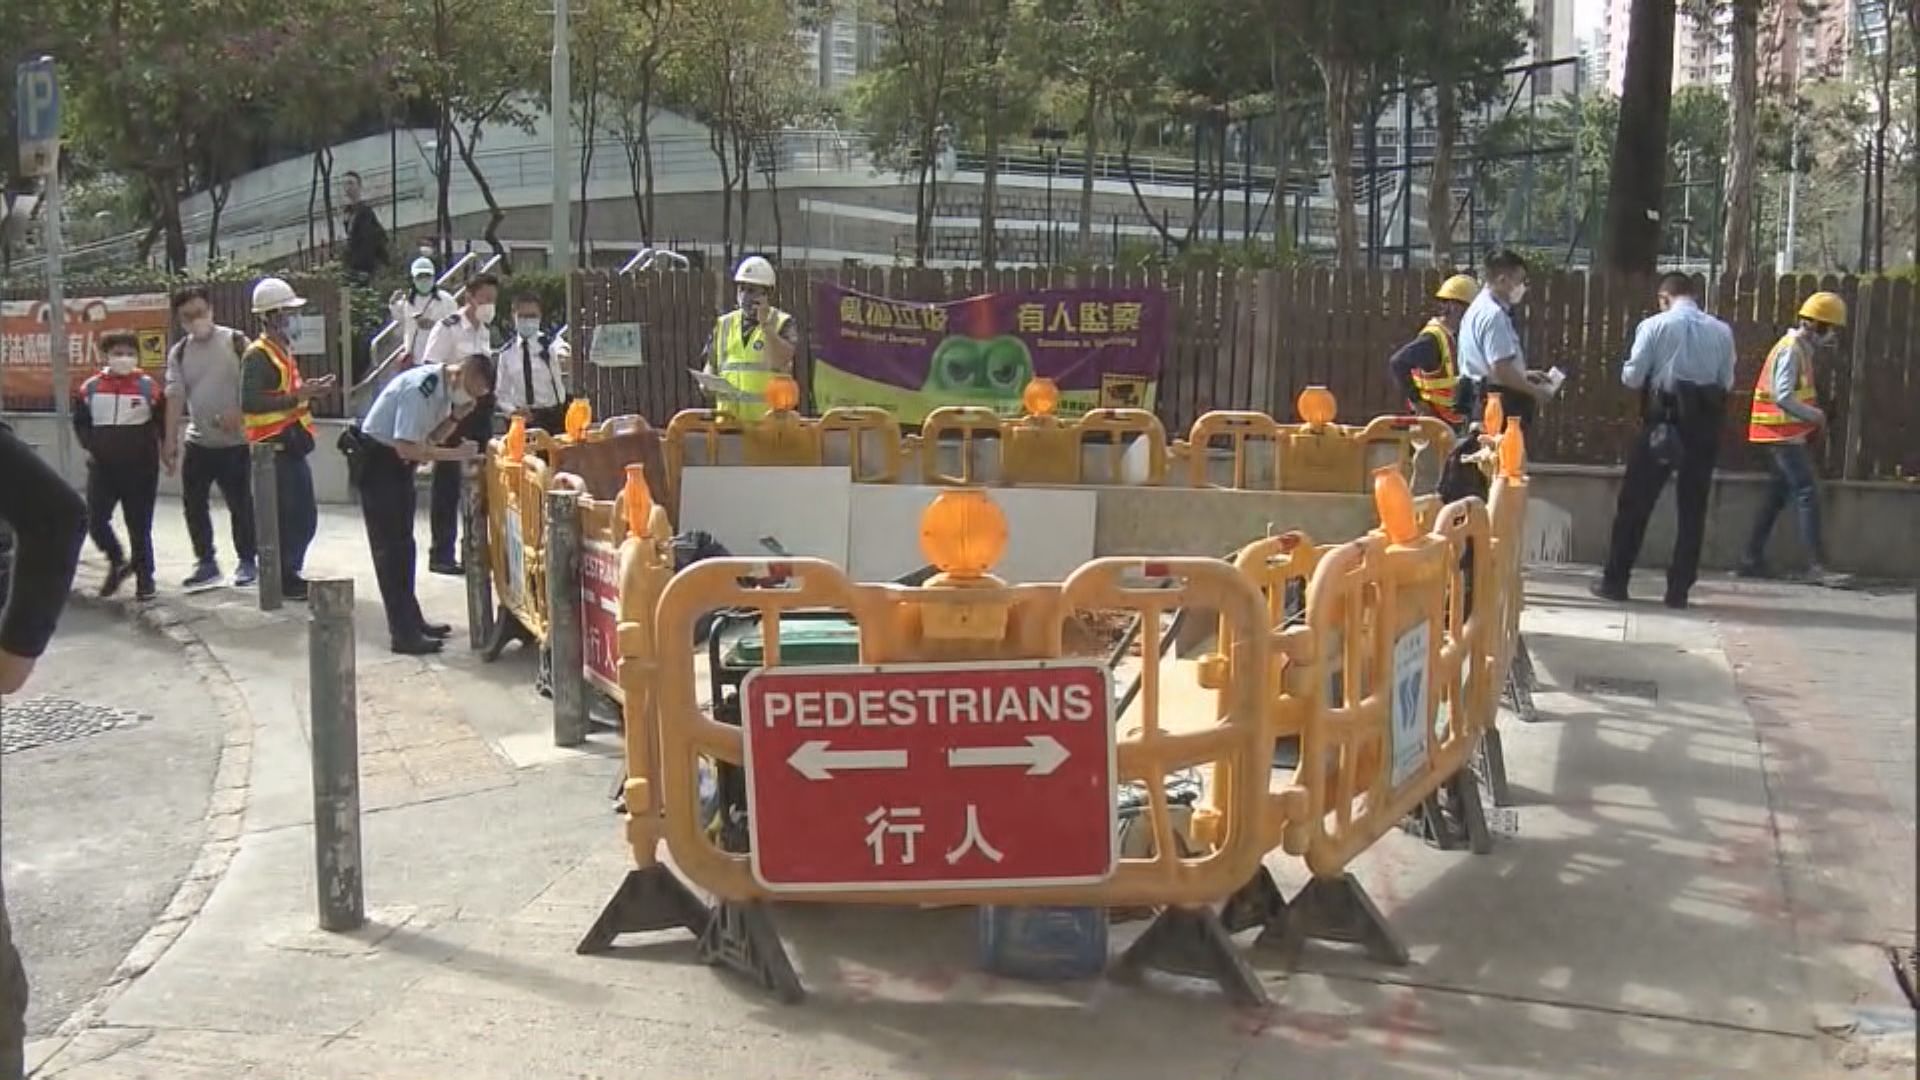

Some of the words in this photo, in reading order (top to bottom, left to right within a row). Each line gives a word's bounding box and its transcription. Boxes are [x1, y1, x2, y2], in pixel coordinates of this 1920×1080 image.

[26, 71, 53, 136] P
[1017, 300, 1142, 333] 有人監察
[763, 684, 1094, 728] PEDESTRIANS
[865, 803, 1004, 866] 行人
